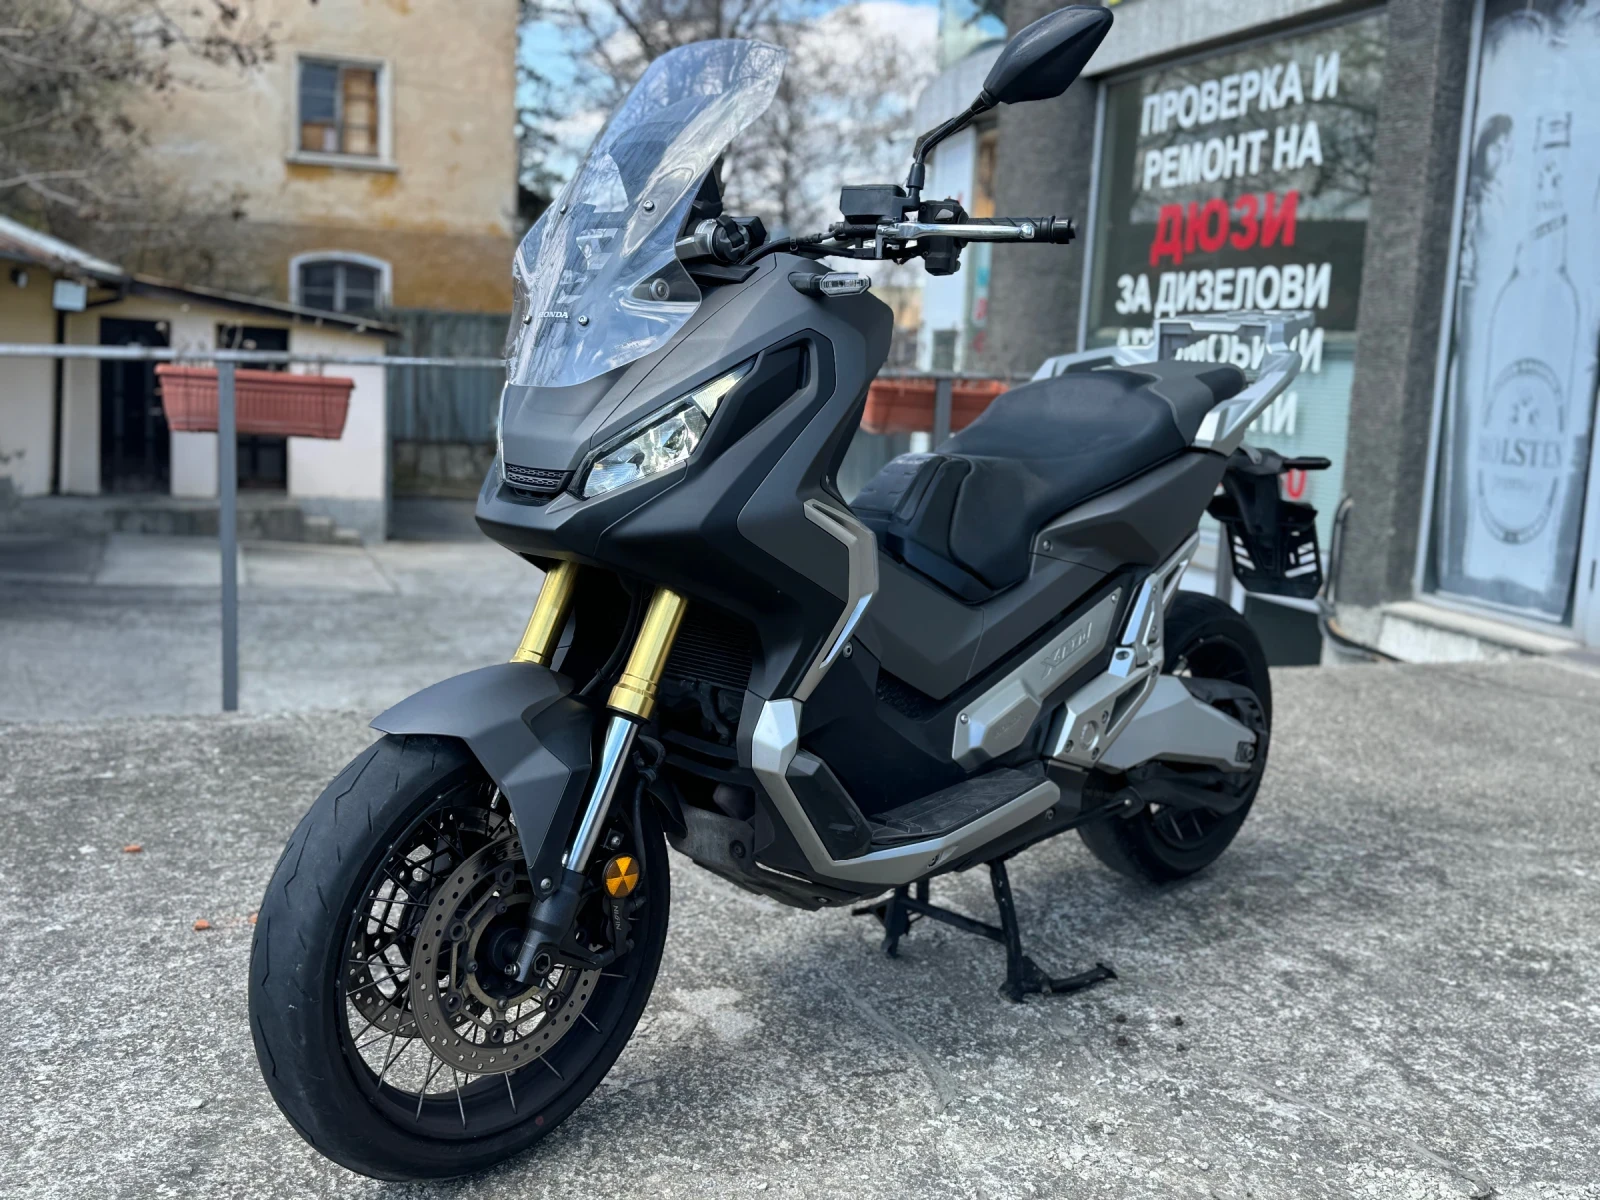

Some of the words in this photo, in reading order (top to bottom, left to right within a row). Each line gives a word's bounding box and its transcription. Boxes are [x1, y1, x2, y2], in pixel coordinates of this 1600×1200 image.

[1141, 60, 1304, 137] ПРОВЕРКА
[1312, 51, 1340, 101] И
[1143, 128, 1268, 190] РЕМОНТ
[1272, 120, 1323, 171] НА
[1149, 189, 1300, 267] ДЮЗИ
[1115, 273, 1152, 315] ЗА
[1154, 262, 1332, 320] ДИЗЕЛОВИ
